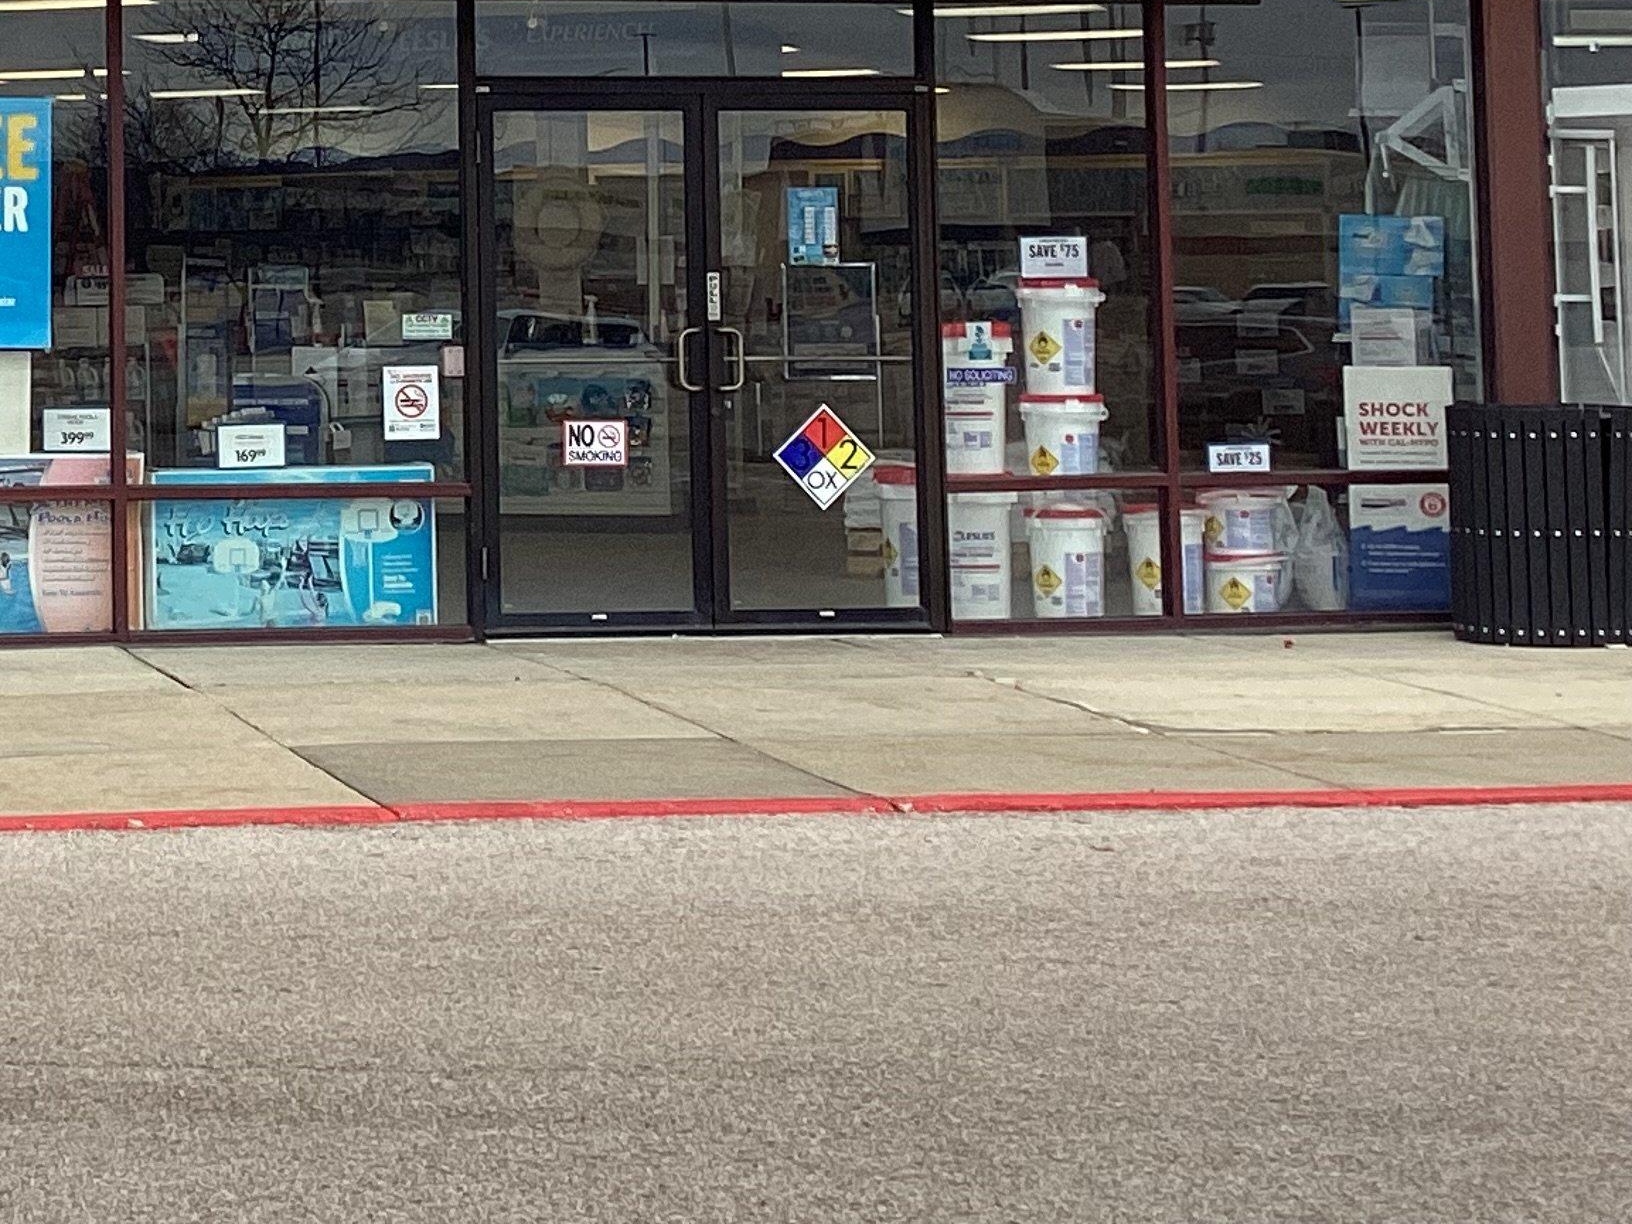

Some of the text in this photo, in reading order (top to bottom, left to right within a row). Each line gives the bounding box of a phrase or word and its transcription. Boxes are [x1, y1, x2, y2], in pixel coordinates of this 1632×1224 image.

[1028, 244, 1058, 258] SAVE
[964, 369, 1013, 382] SOLICITING
[1358, 402, 1430, 417] SHOCK
[568, 424, 595, 447] NO
[817, 417, 827, 450] 1
[1359, 421, 1439, 436] WEEKLY
[568, 450, 622, 462] SMOKING
[792, 438, 811, 471] 3
[838, 438, 858, 470] 2
[1216, 451, 1242, 466] SAVE
[807, 471, 838, 490] OX
